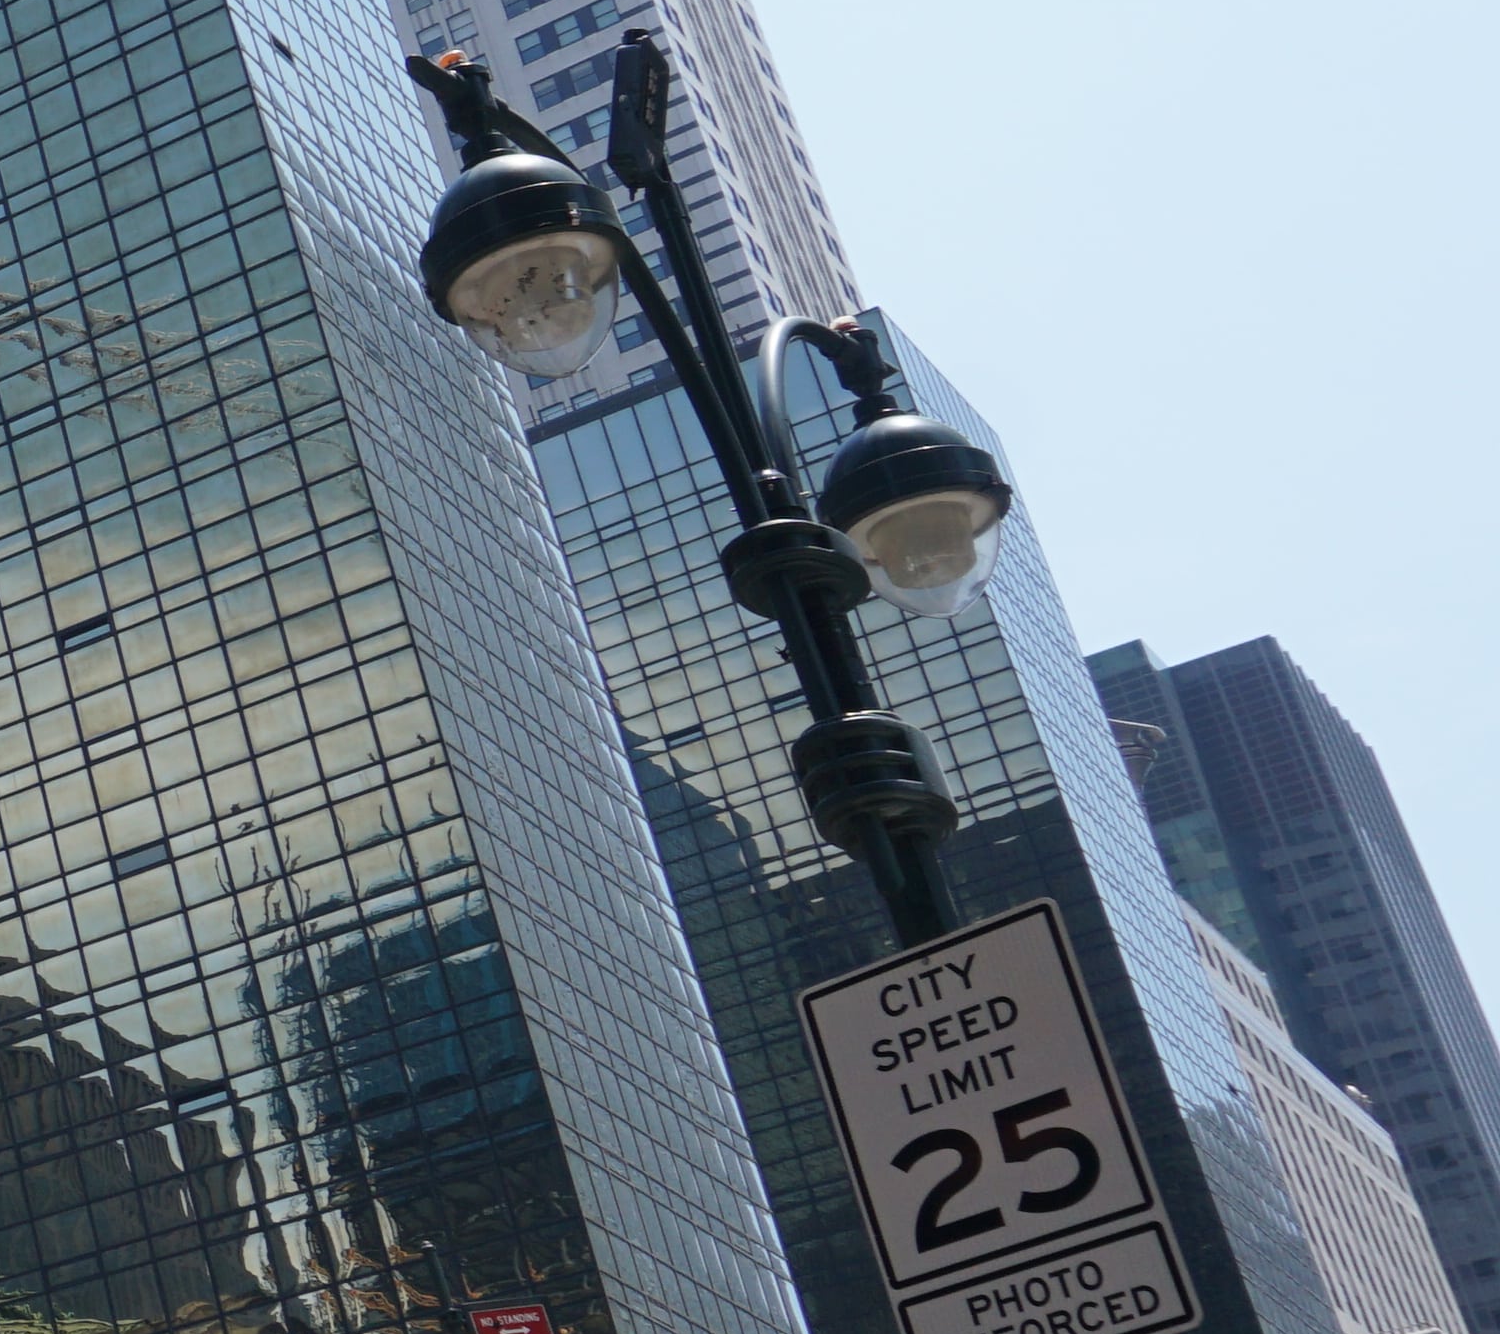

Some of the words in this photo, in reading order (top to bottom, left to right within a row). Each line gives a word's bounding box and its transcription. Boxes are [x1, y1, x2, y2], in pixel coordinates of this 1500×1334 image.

[878, 953, 976, 1017] CITY
[871, 995, 1019, 1072] SPEED
[900, 1044, 1016, 1115] LIMIT
[889, 1087, 1101, 1254] 25
[480, 1317, 494, 1327] NO
[497, 1312, 541, 1325] STANDING
[966, 1260, 1104, 1326] PHOTO
